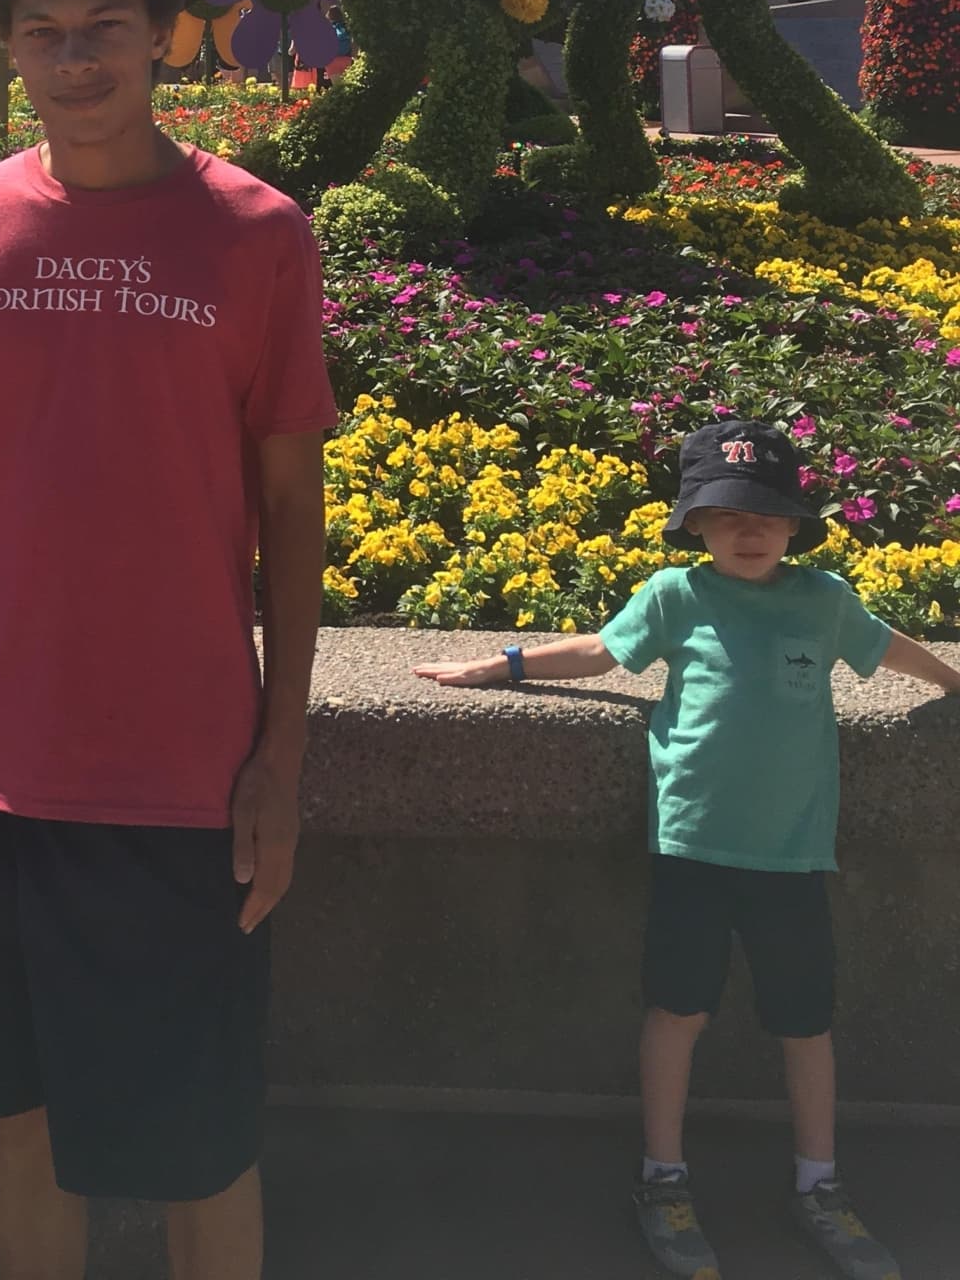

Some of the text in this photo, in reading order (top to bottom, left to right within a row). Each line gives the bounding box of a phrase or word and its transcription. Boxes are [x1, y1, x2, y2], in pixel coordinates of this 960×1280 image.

[35, 255, 152, 284] DACEY'S
[114, 286, 217, 328] TOURS
[722, 441, 757, 463] 71
